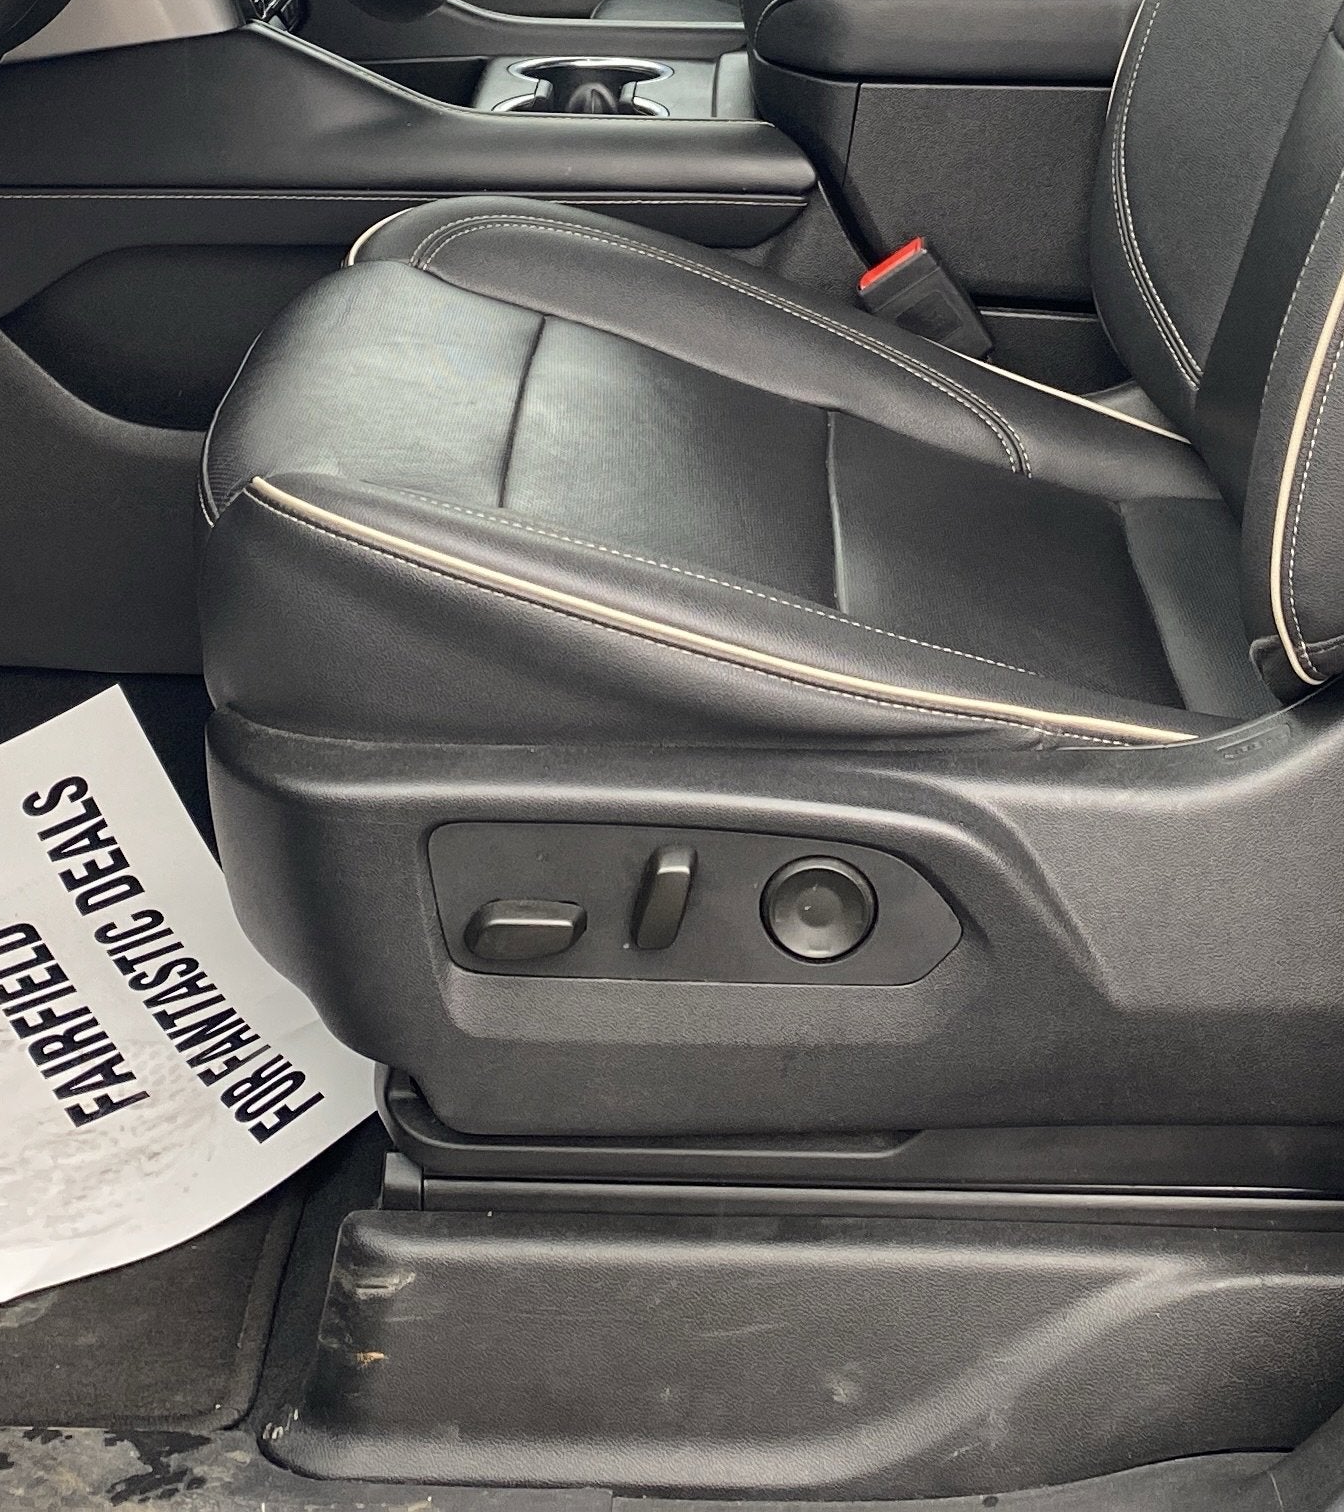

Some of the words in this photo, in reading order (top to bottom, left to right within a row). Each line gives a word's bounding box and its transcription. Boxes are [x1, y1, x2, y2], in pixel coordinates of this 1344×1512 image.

[21, 775, 145, 917] DEALS
[93, 909, 272, 1087] FANTASTIC
[219, 1053, 325, 1144] FOR
